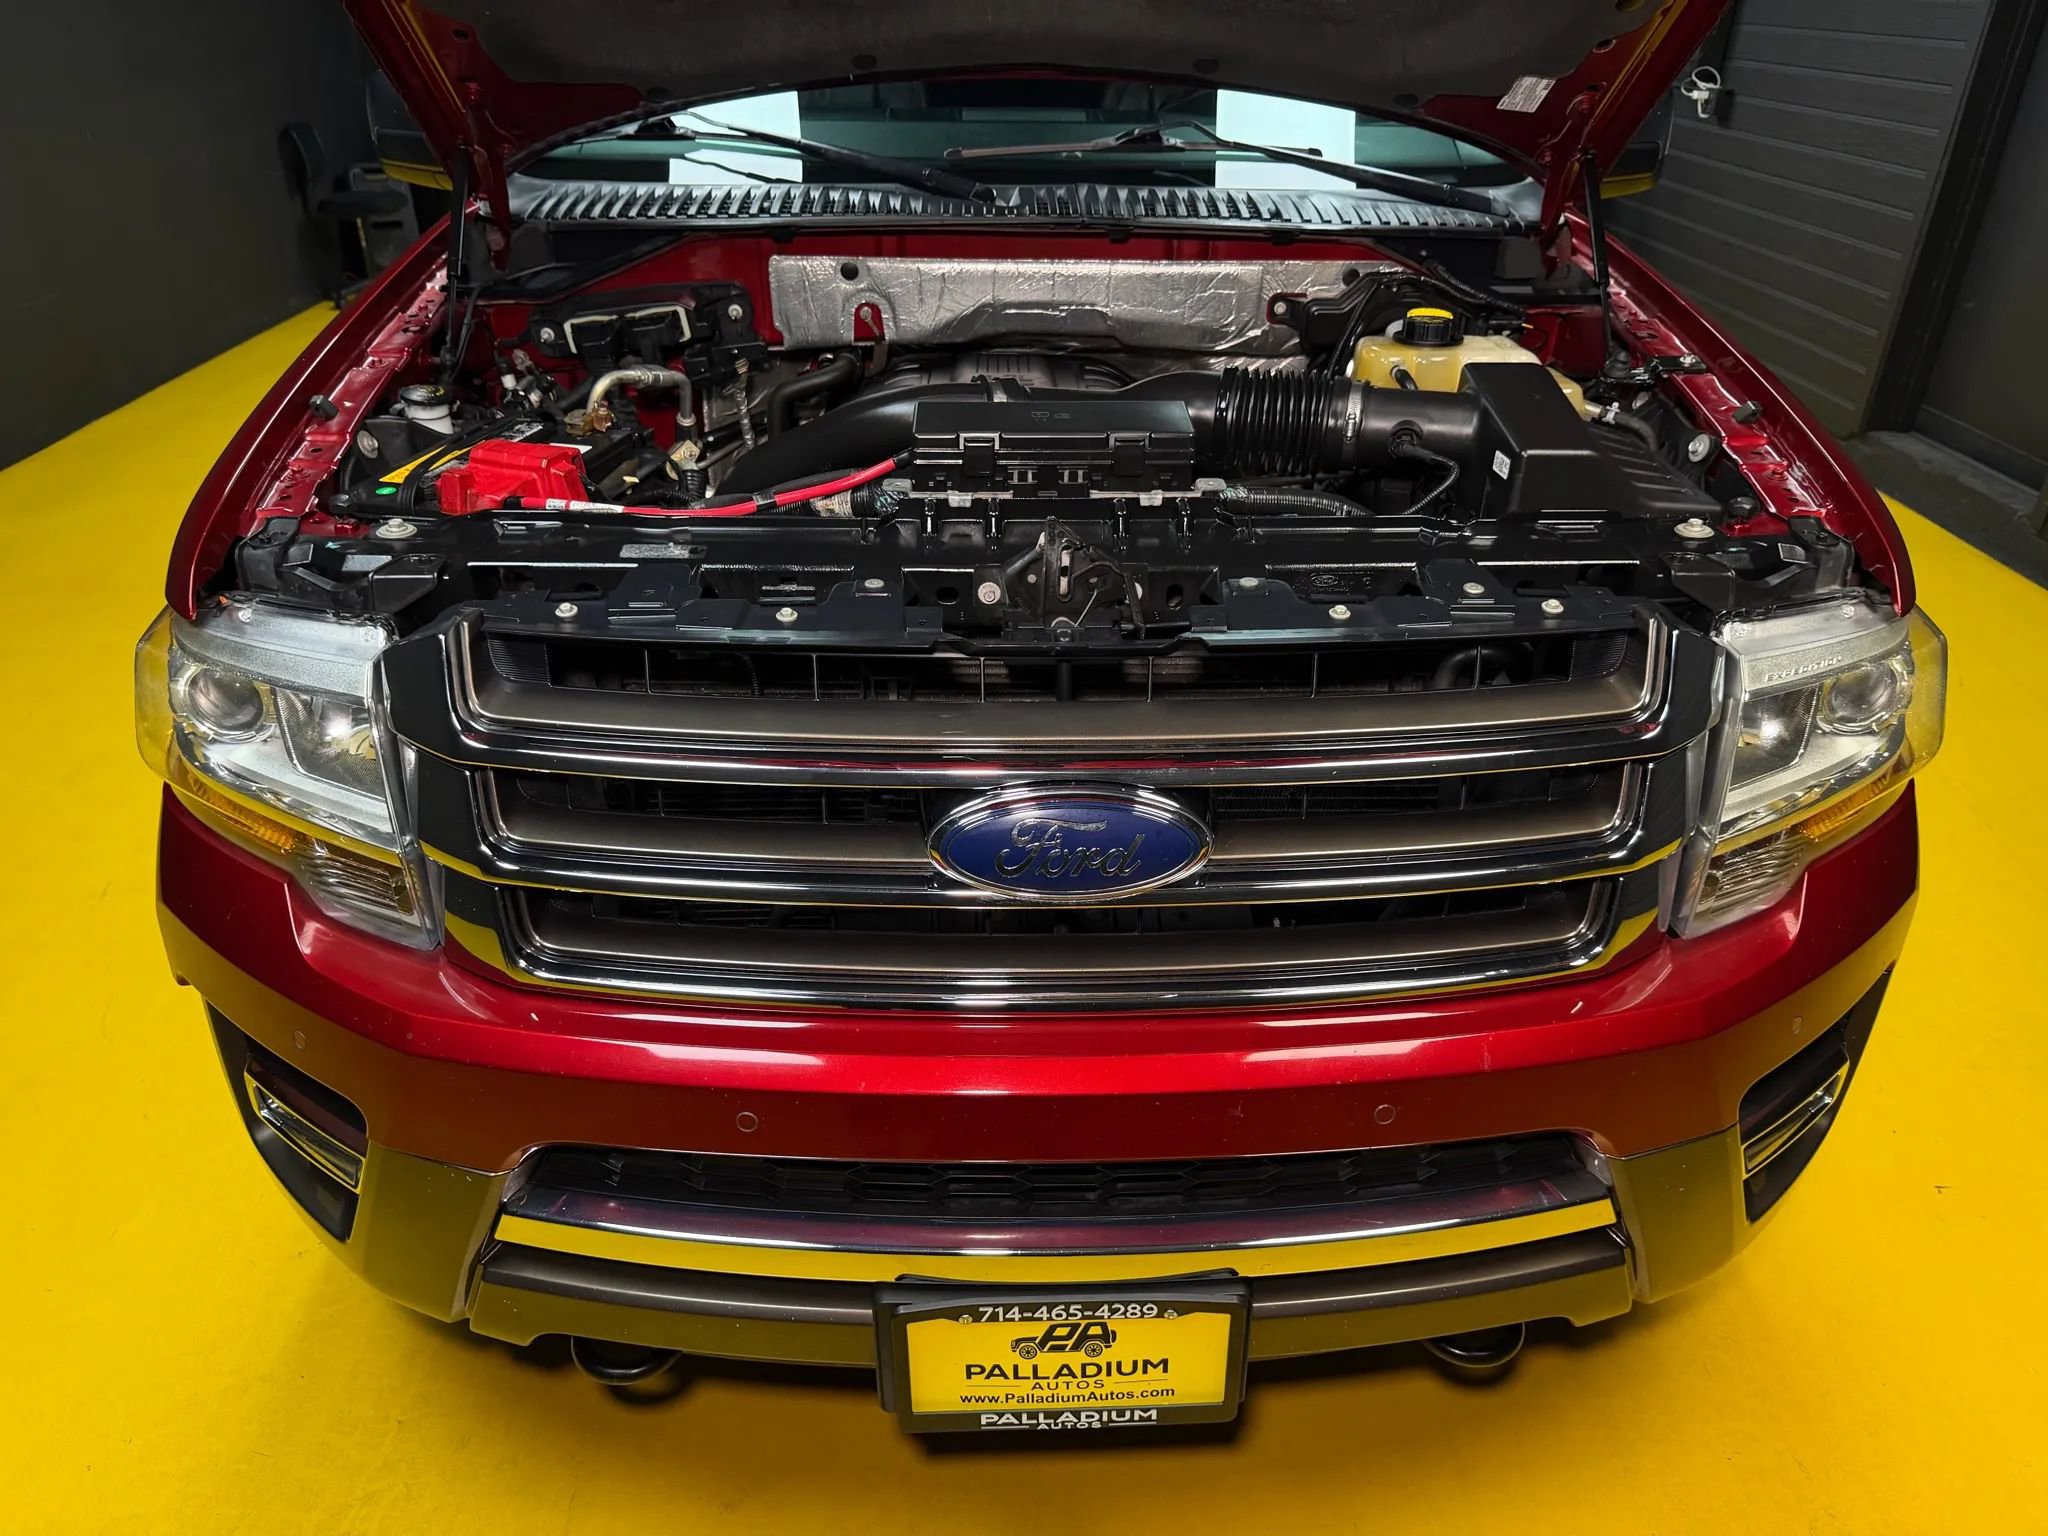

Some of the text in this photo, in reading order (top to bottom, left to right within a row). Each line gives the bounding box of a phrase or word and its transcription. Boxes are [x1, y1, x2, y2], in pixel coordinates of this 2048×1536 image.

[995, 817, 1145, 878] Ford
[979, 1303, 1158, 1323] 714-465-4289
[965, 1358, 1169, 1380] PALLADIUM
[1031, 1379, 1105, 1391] AUTOS
[960, 1387, 1175, 1404] www.PalladiumAutos.com
[980, 1409, 1157, 1425] PALLADIUM
[1036, 1421, 1102, 1430] AUTOS
